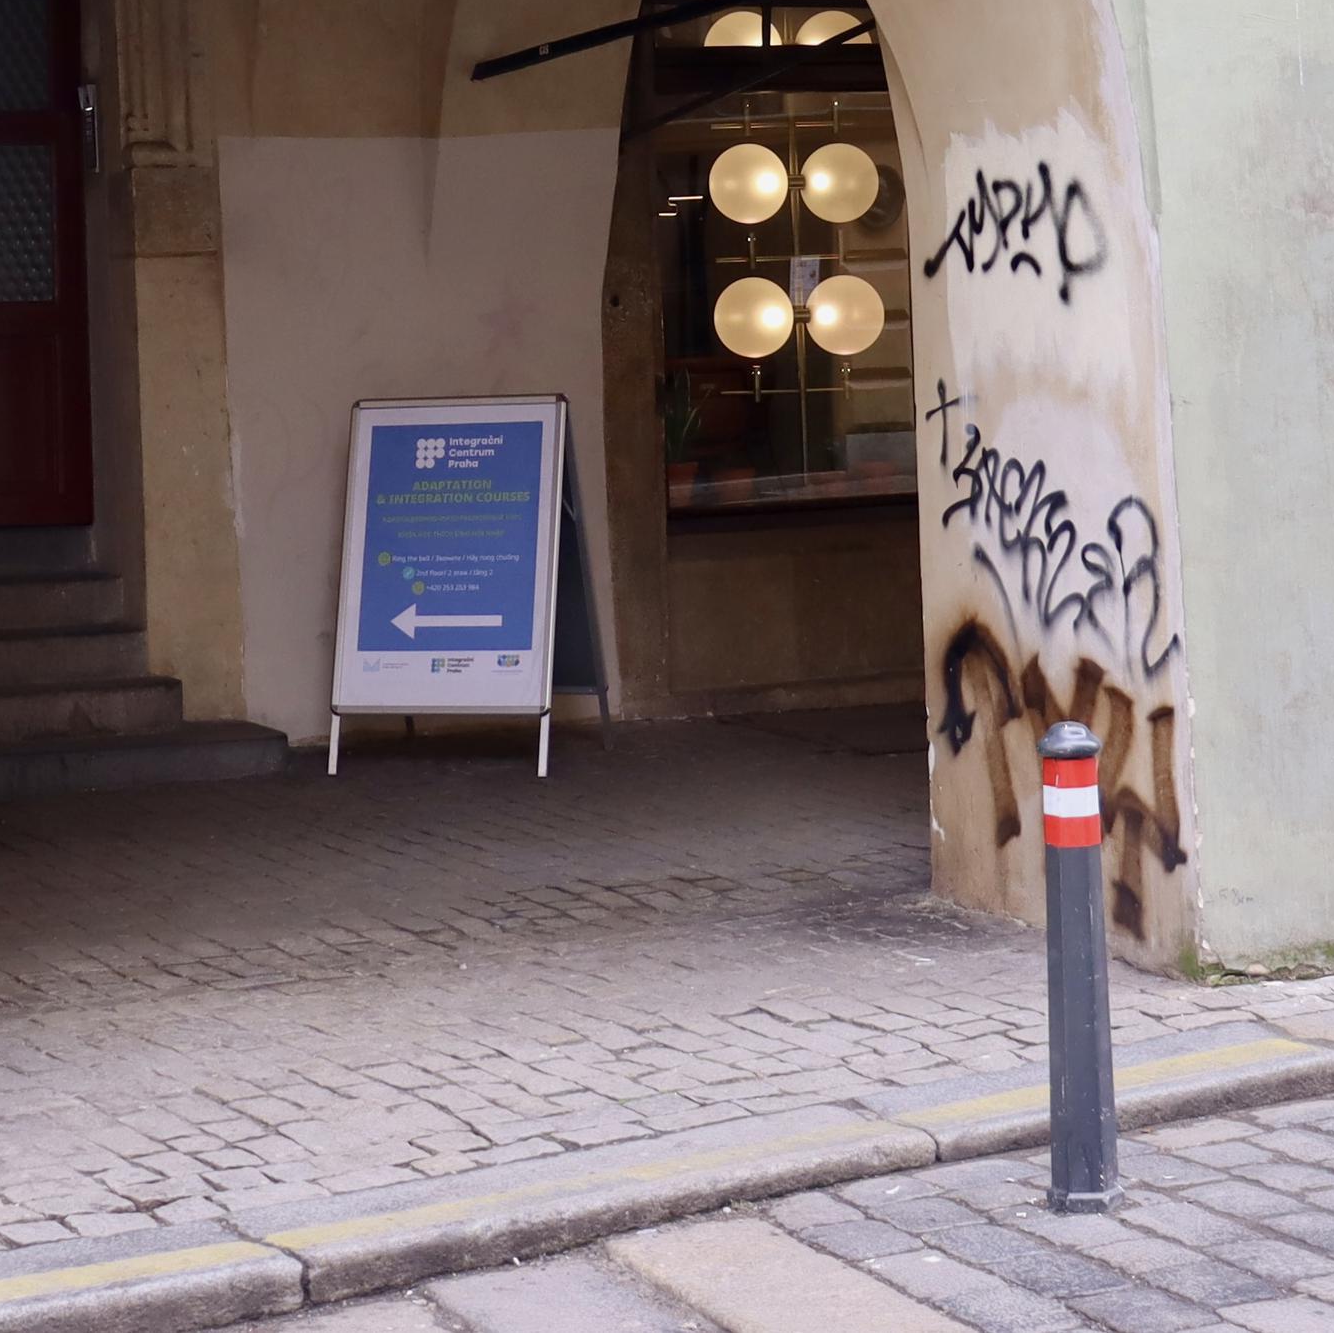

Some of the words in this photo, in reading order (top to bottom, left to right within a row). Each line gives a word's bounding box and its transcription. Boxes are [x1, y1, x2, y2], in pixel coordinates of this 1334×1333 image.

[449, 435, 503, 448] Integrační
[449, 448, 495, 458] Centrum
[448, 459, 479, 468] Praha
[412, 479, 492, 491] ADAPTATION
[376, 494, 386, 505] &
[389, 492, 473, 504] INTEGRATION
[476, 491, 531, 503] COURSES
